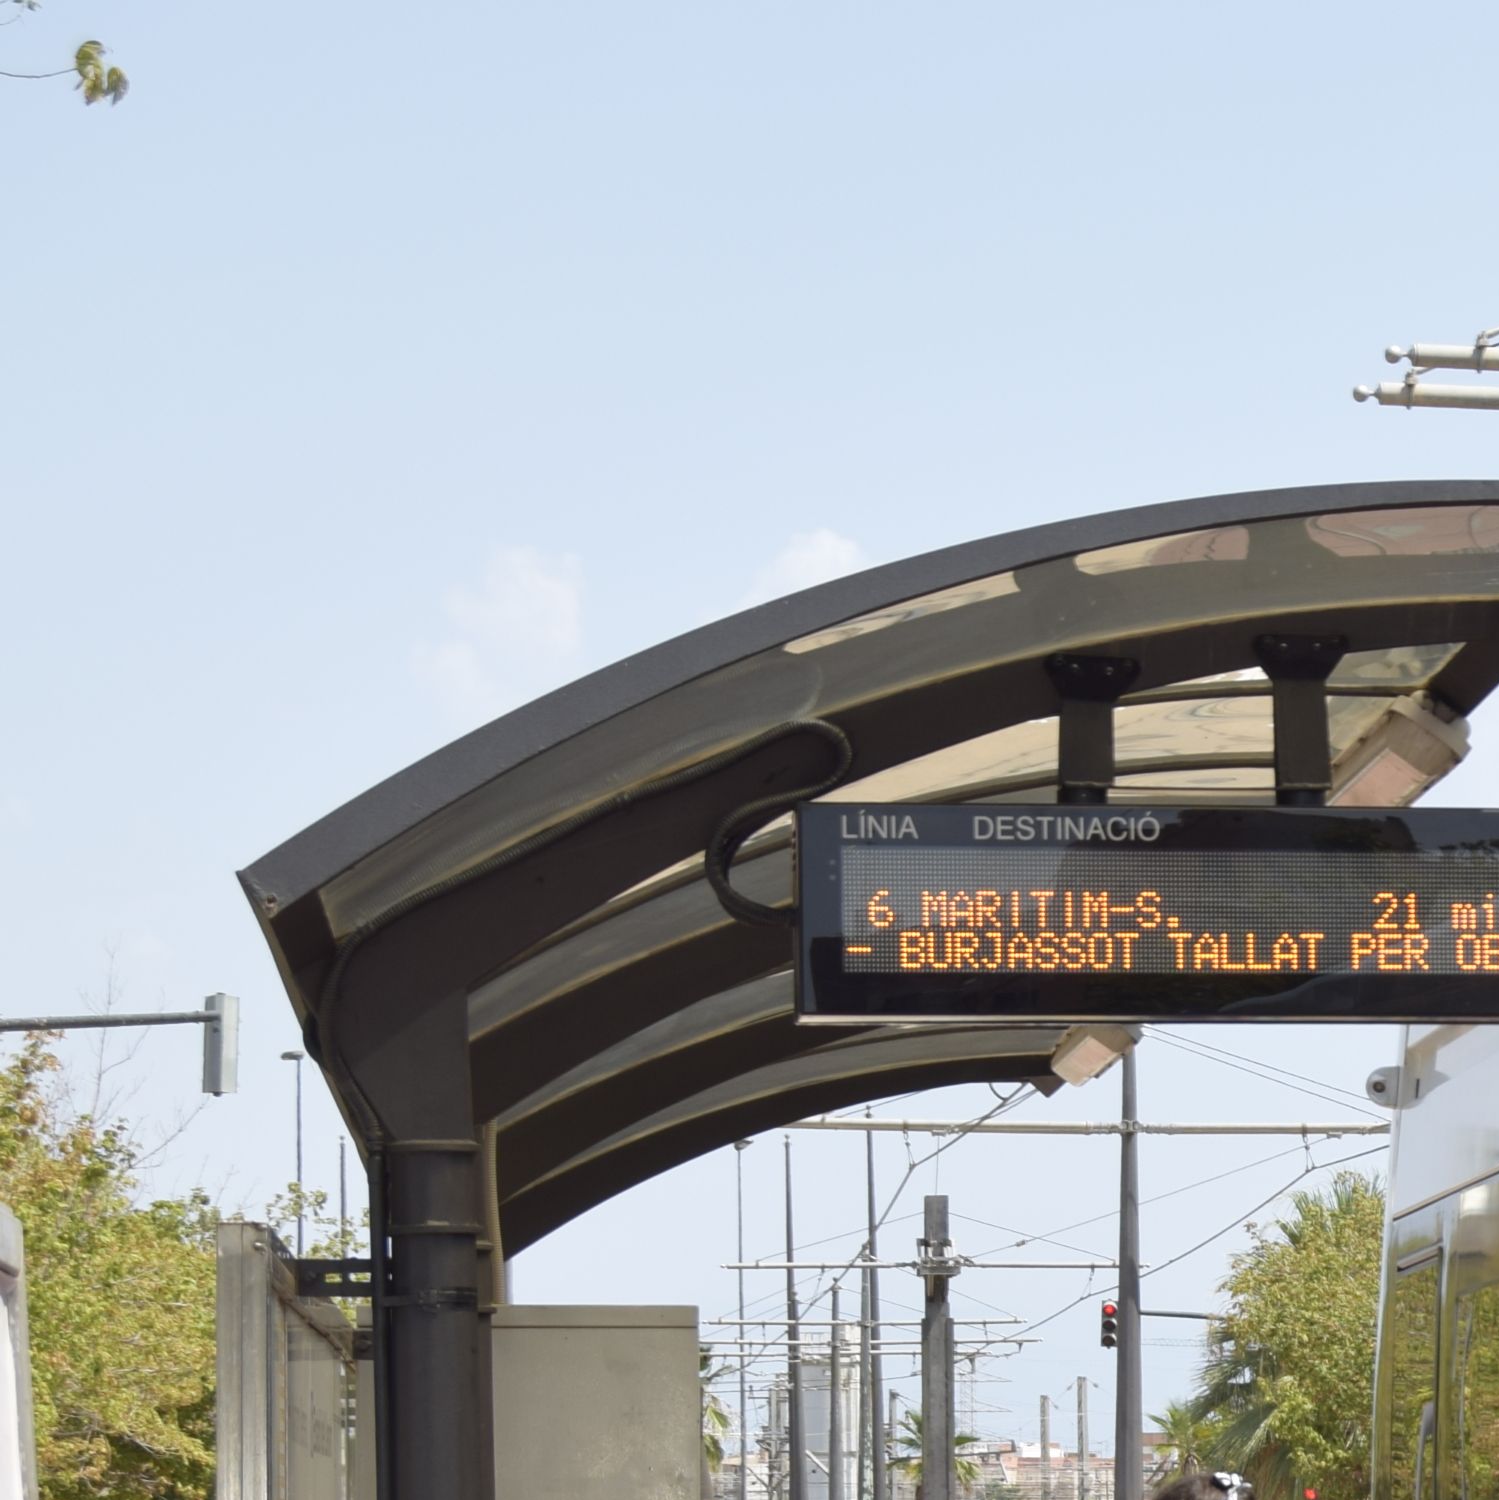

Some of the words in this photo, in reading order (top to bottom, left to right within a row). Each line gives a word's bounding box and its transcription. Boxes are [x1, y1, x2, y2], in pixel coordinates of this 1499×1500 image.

[840, 812, 919, 841] LÍNIA
[973, 811, 1161, 843] DESTINACIÓ
[867, 890, 896, 928] 6
[921, 890, 1181, 929] MARITIM-S.
[1372, 892, 1421, 930] 21
[899, 931, 1142, 971] BURJASSOT
[1167, 932, 1325, 971] TALLAT
[1350, 932, 1431, 972] PER
